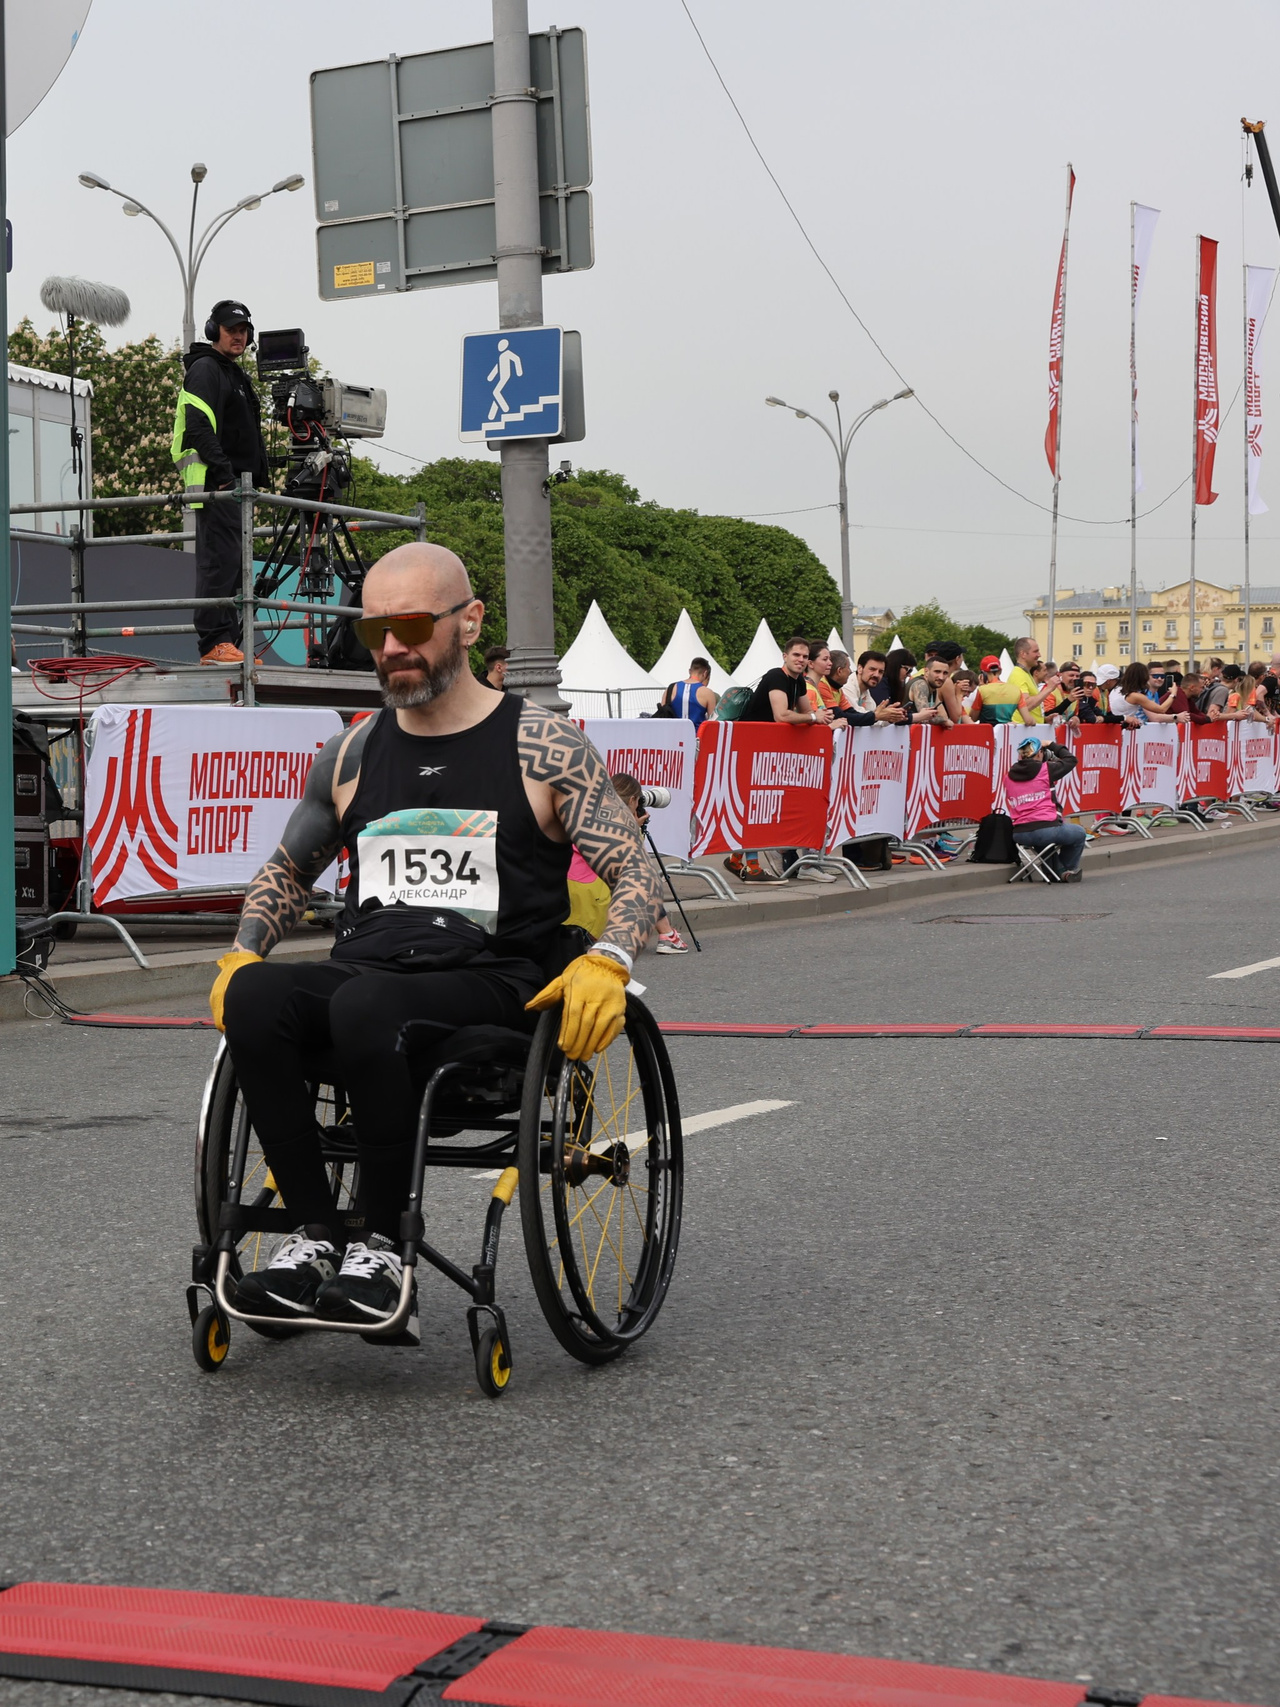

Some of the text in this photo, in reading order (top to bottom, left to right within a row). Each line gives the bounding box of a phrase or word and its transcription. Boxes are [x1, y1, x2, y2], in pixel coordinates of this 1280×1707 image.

[189, 741, 324, 801] МОСКОВСКИ
[750, 748, 825, 790] МОСКОВСКИЙ
[943, 741, 990, 779] МОСКОВСКИЙ
[942, 773, 967, 802] СПОРТ
[747, 789, 785, 825] СПОРТ
[187, 805, 253, 855] СПОРТ
[380, 848, 481, 887] 1534
[389, 888, 468, 901] АЛЕКСАНДР
